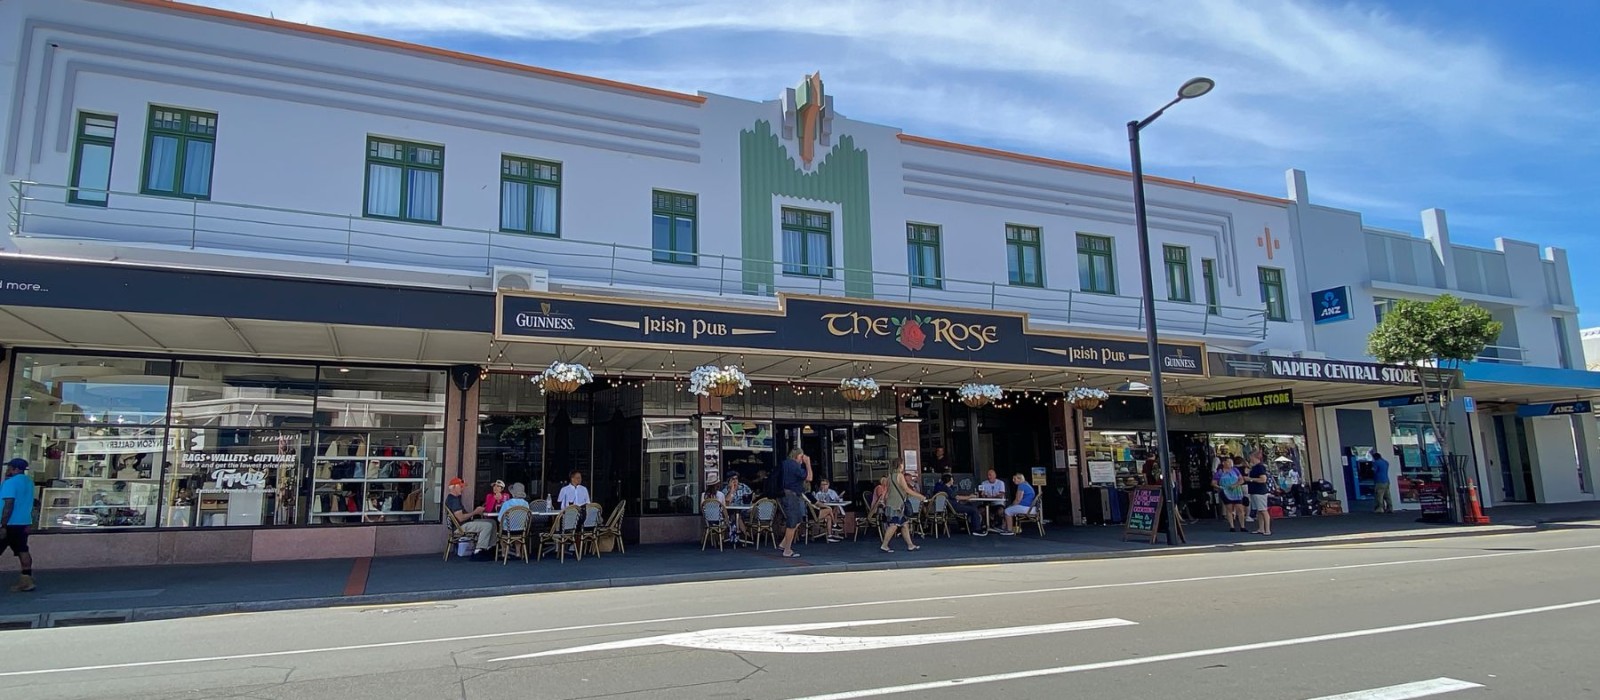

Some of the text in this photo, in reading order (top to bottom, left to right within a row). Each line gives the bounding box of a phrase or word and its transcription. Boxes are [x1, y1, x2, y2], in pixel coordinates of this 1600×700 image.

[1320, 305, 1341, 317] ANZ
[1271, 359, 1419, 384] NAPIER CENTRAL STORE
[1228, 395, 1263, 409] CENTRAL
[1263, 392, 1290, 405] STORE
